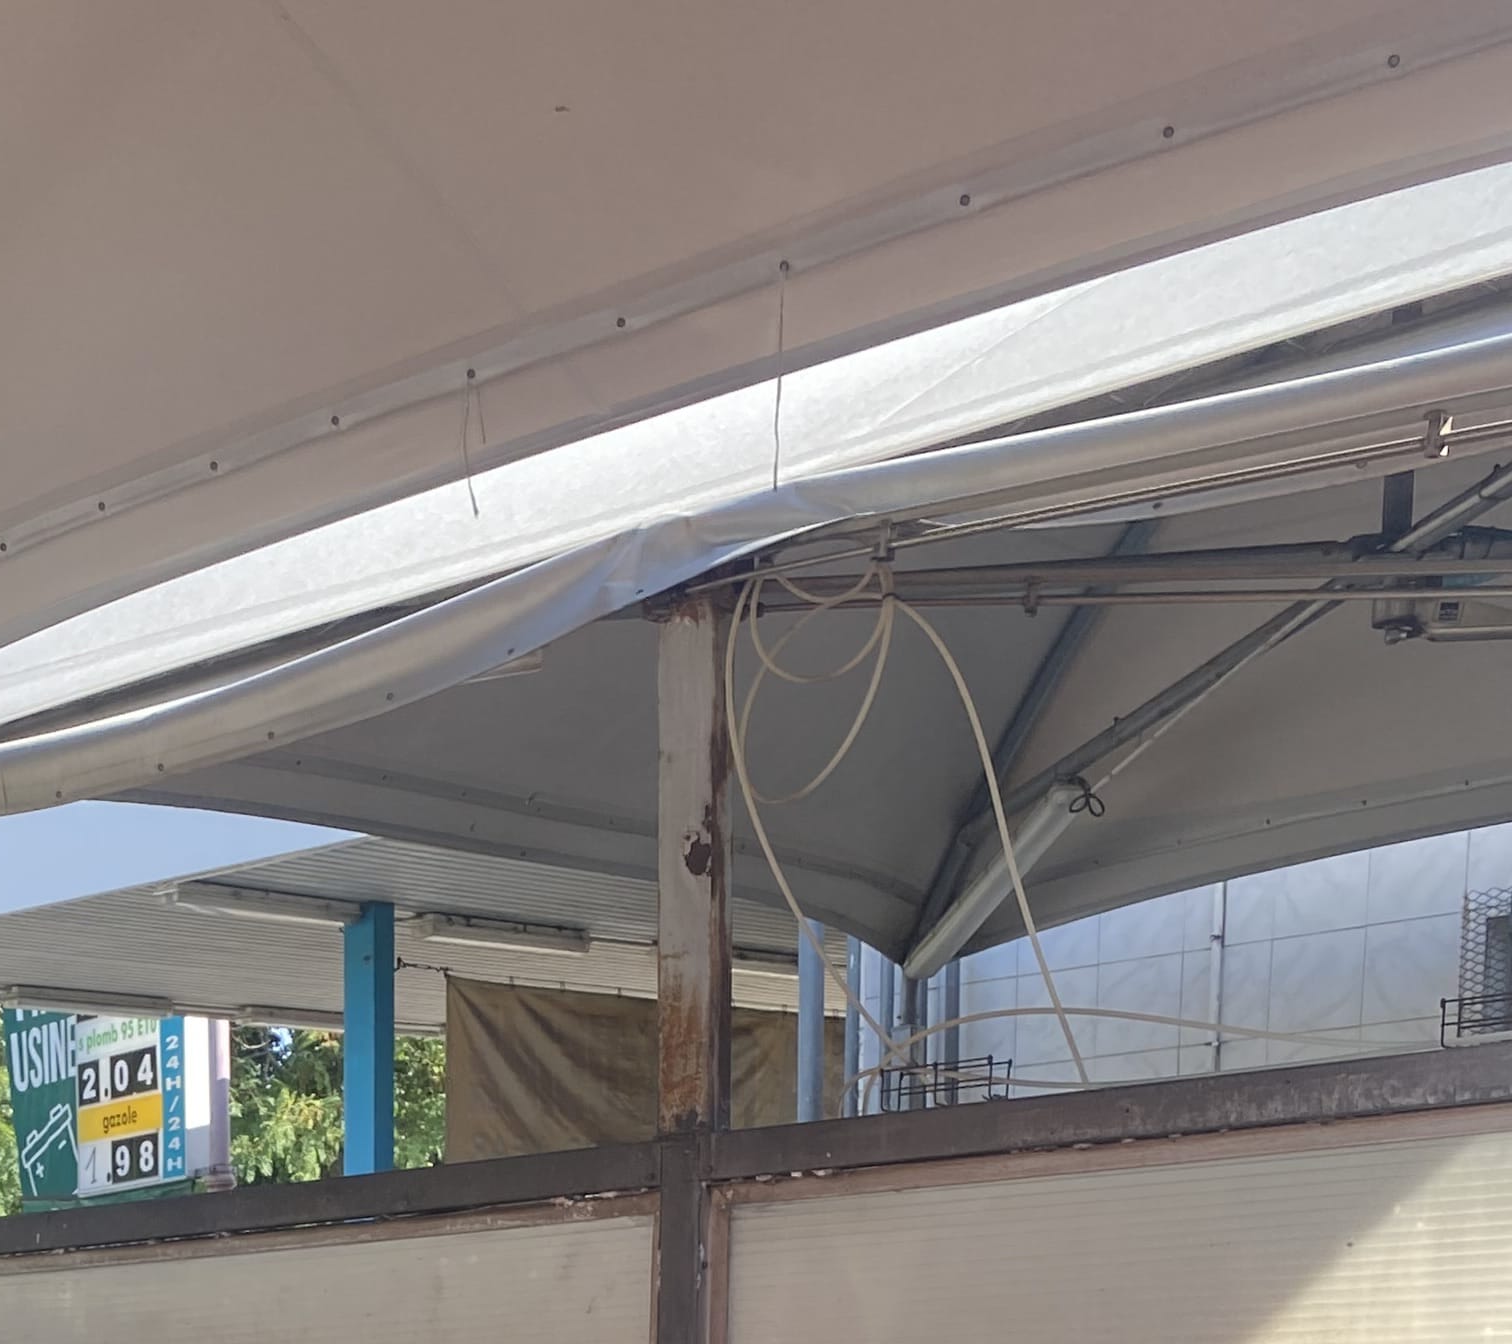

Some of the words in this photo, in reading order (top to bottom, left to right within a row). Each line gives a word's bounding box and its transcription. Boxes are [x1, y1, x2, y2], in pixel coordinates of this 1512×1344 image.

[10, 1015, 77, 1092] USINE
[85, 1022, 119, 1055] plomb
[120, 1019, 134, 1041] 95
[82, 1053, 154, 1101] 2.04
[102, 1105, 138, 1134] gazole
